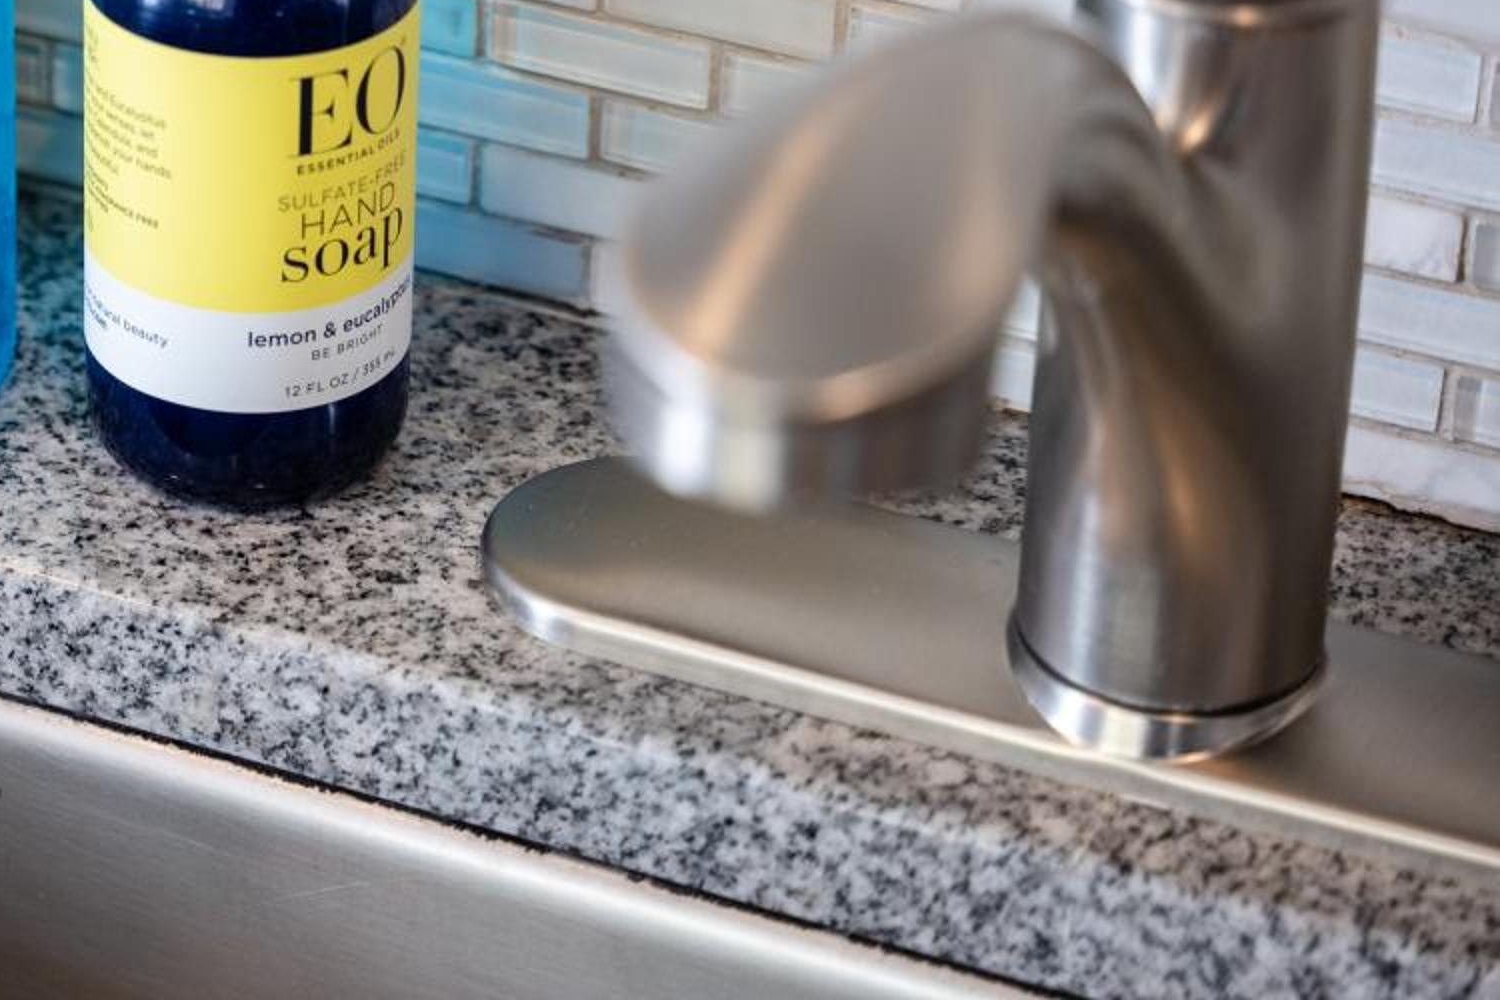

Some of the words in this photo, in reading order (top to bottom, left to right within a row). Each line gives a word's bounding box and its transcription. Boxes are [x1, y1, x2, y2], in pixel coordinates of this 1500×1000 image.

[287, 46, 405, 157] EO
[297, 146, 375, 176] ESSENTIAL
[301, 181, 394, 240] HAND
[282, 207, 402, 282] soap
[123, 318, 168, 348] beauty
[248, 329, 316, 348] lemon
[323, 321, 337, 338] &
[343, 273, 411, 332] eucalyp
[311, 348, 330, 361] BE
[337, 324, 383, 355] BRIGHT
[285, 386, 301, 398] 12
[306, 381, 324, 395] FL
[329, 373, 348, 389] OZ
